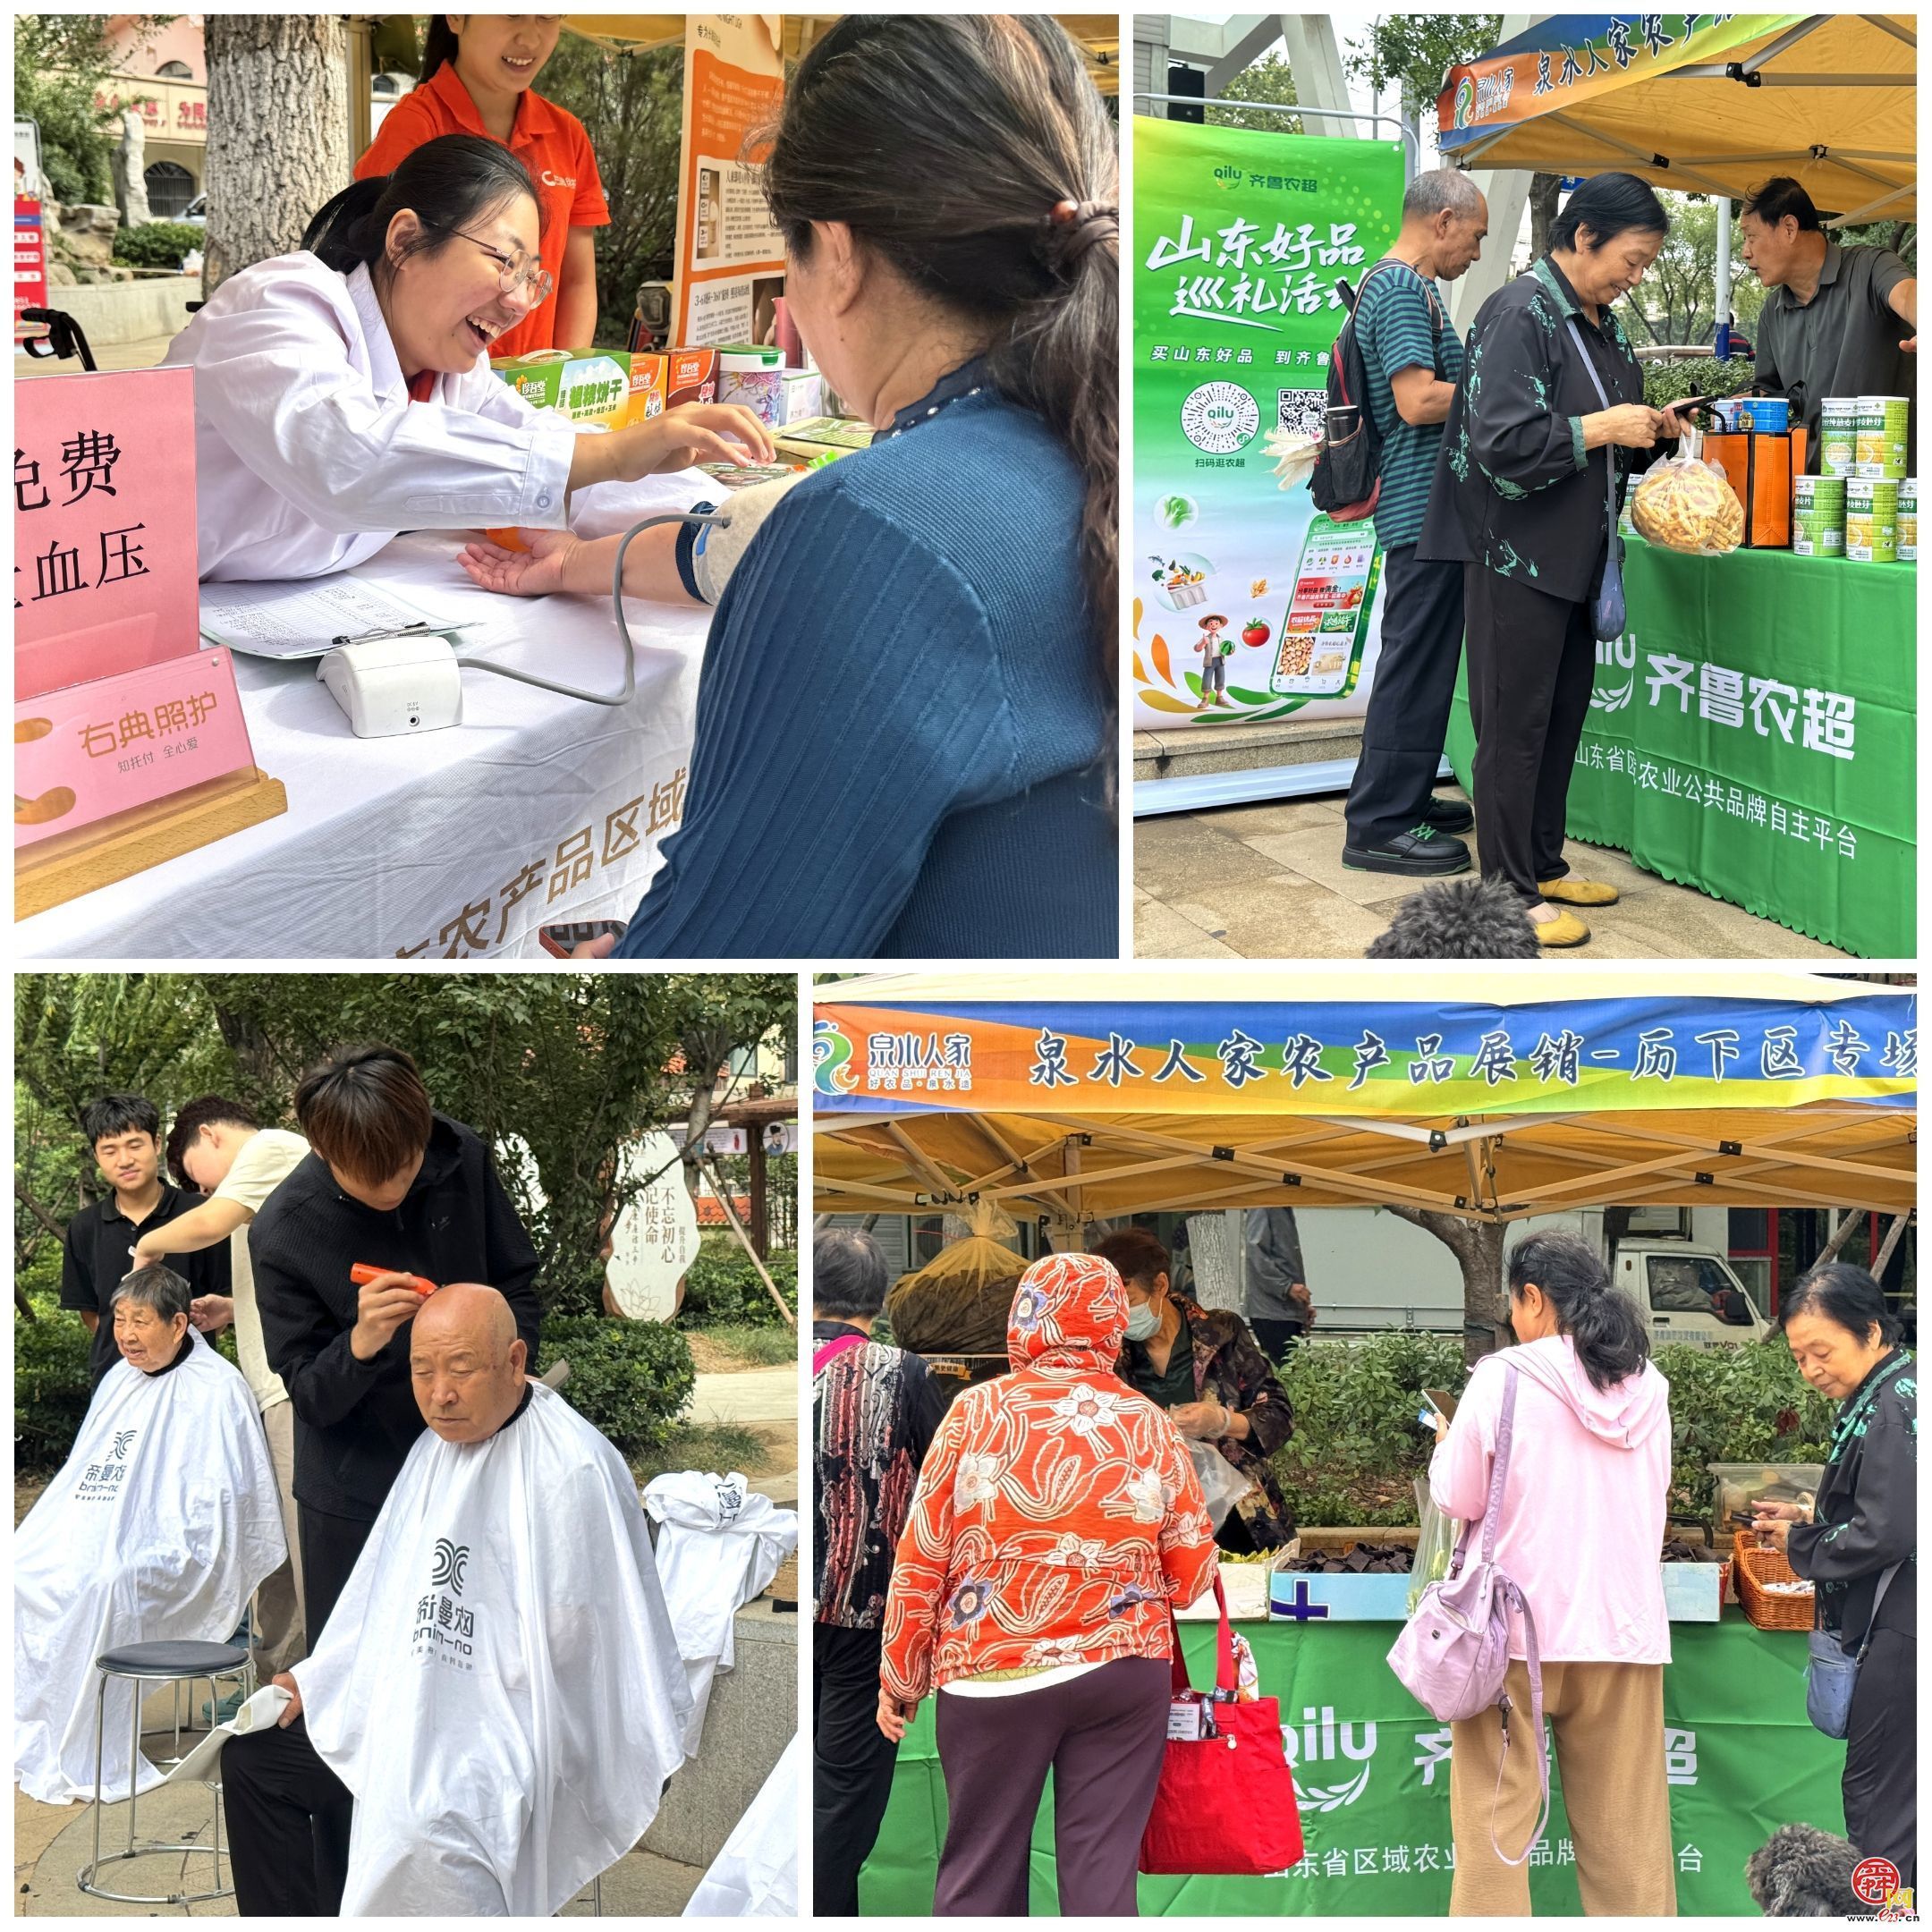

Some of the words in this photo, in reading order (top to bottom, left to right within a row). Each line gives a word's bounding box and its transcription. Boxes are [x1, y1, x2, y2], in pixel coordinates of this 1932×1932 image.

[1214, 165, 1242, 182] qilu
[1249, 174, 1318, 193] 齐鲁农超
[1145, 215, 1366, 272] 山东好品
[1150, 345, 1253, 364] 买山东好品
[569, 378, 623, 410] 粗粮饼干
[1208, 406, 1234, 421] qilu
[14, 429, 122, 512] 免费
[1195, 457, 1245, 469] 扫码逛农超
[14, 522, 151, 609] 血压
[78, 691, 217, 758] 右典照护
[1645, 653, 1856, 760] 齐鲁农超
[117, 751, 154, 773] 知托付
[163, 737, 199, 758] 全心爱
[395, 767, 686, 959] 农产品区域
[869, 1032, 972, 1068] 泉水人家
[869, 1069, 899, 1078] QUAN
[903, 1069, 927, 1078] SHUI
[931, 1069, 952, 1078] REN
[956, 1069, 971, 1078] JIA
[645, 1166, 659, 1245] 记使命
[661, 1186, 675, 1263] 不忘初心
